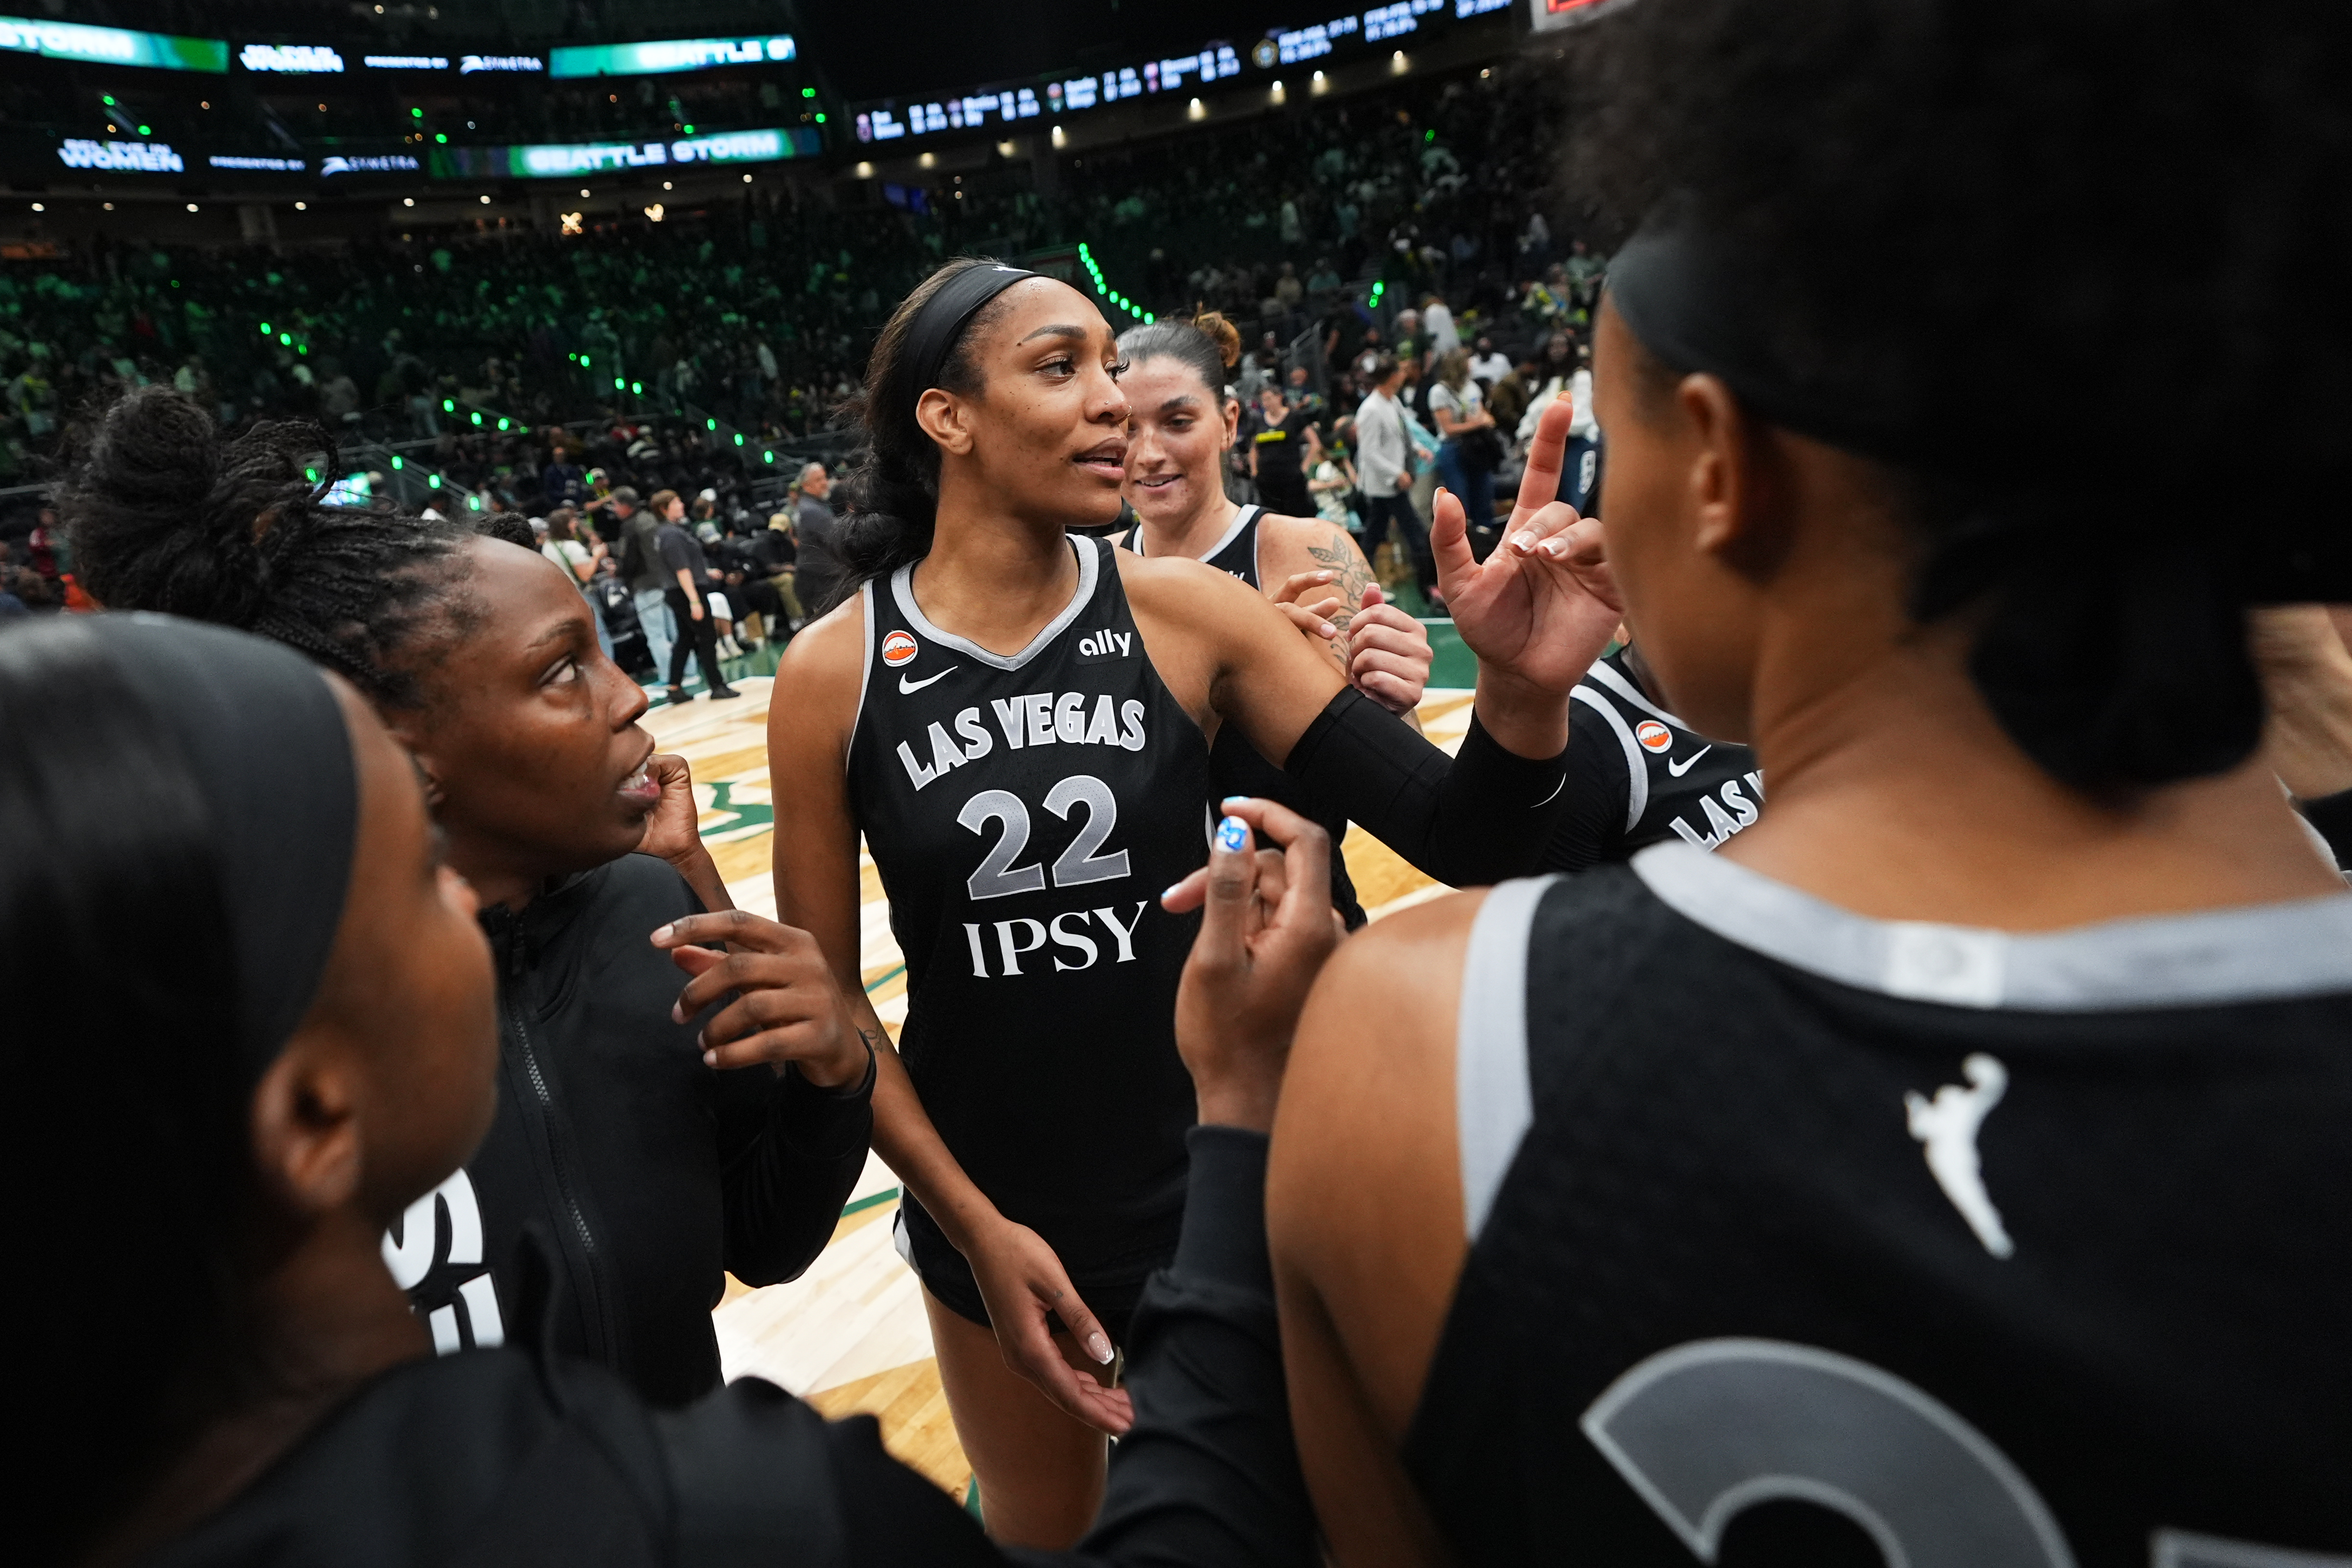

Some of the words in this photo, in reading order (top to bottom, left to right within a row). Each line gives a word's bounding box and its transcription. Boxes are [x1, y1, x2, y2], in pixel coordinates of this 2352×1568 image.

[57, 148, 184, 172] WOMEN
[528, 143, 666, 170] SEATTLE
[672, 134, 778, 162] STORM
[1079, 629, 1131, 657] ally
[897, 707, 992, 791] LAS
[991, 692, 1145, 751] VEGAS
[957, 775, 1131, 900] 22
[1669, 780, 1758, 851] LAS
[962, 900, 1148, 978] IPSY
